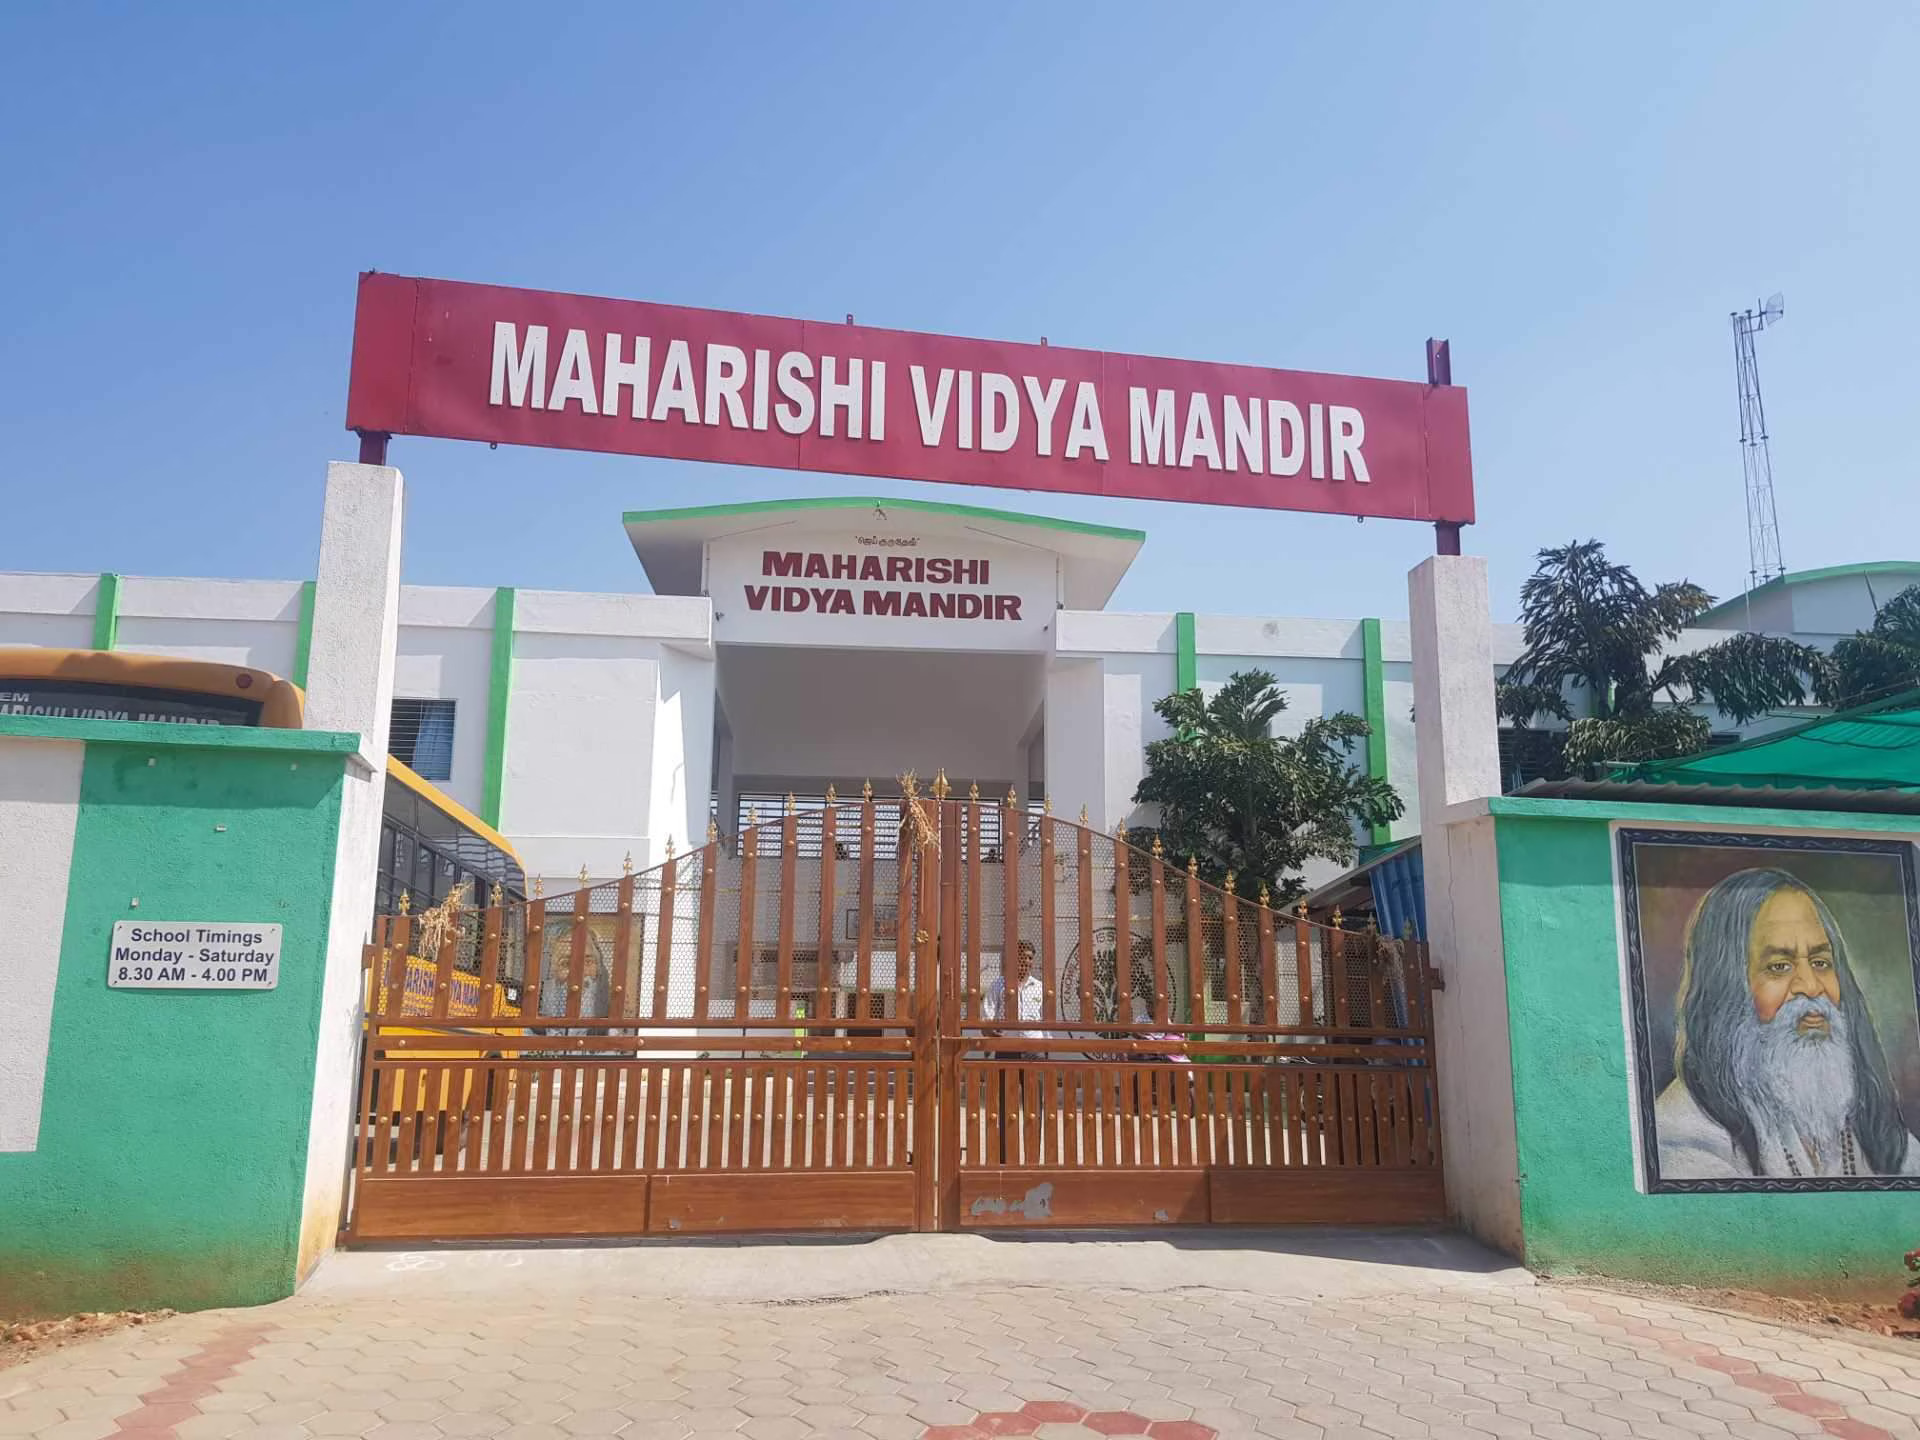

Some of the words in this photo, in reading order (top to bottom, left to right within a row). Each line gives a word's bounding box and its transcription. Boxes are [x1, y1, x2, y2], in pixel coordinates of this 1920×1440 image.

[489, 321, 887, 442] MAHARISHI
[908, 364, 1110, 462] VIDYA
[1129, 386, 1372, 483] MANDIR
[762, 551, 990, 585] MAHARISHI
[743, 585, 857, 615] VIDYA
[863, 590, 1023, 621] MANDIR
[131, 928, 191, 943] School
[196, 929, 263, 947] Timings
[115, 947, 183, 965] Monday
[199, 949, 275, 966] Saturday
[118, 967, 153, 981] 8.30
[157, 967, 185, 981] AM
[202, 968, 236, 982] 4.00
[241, 968, 268, 982] PM
